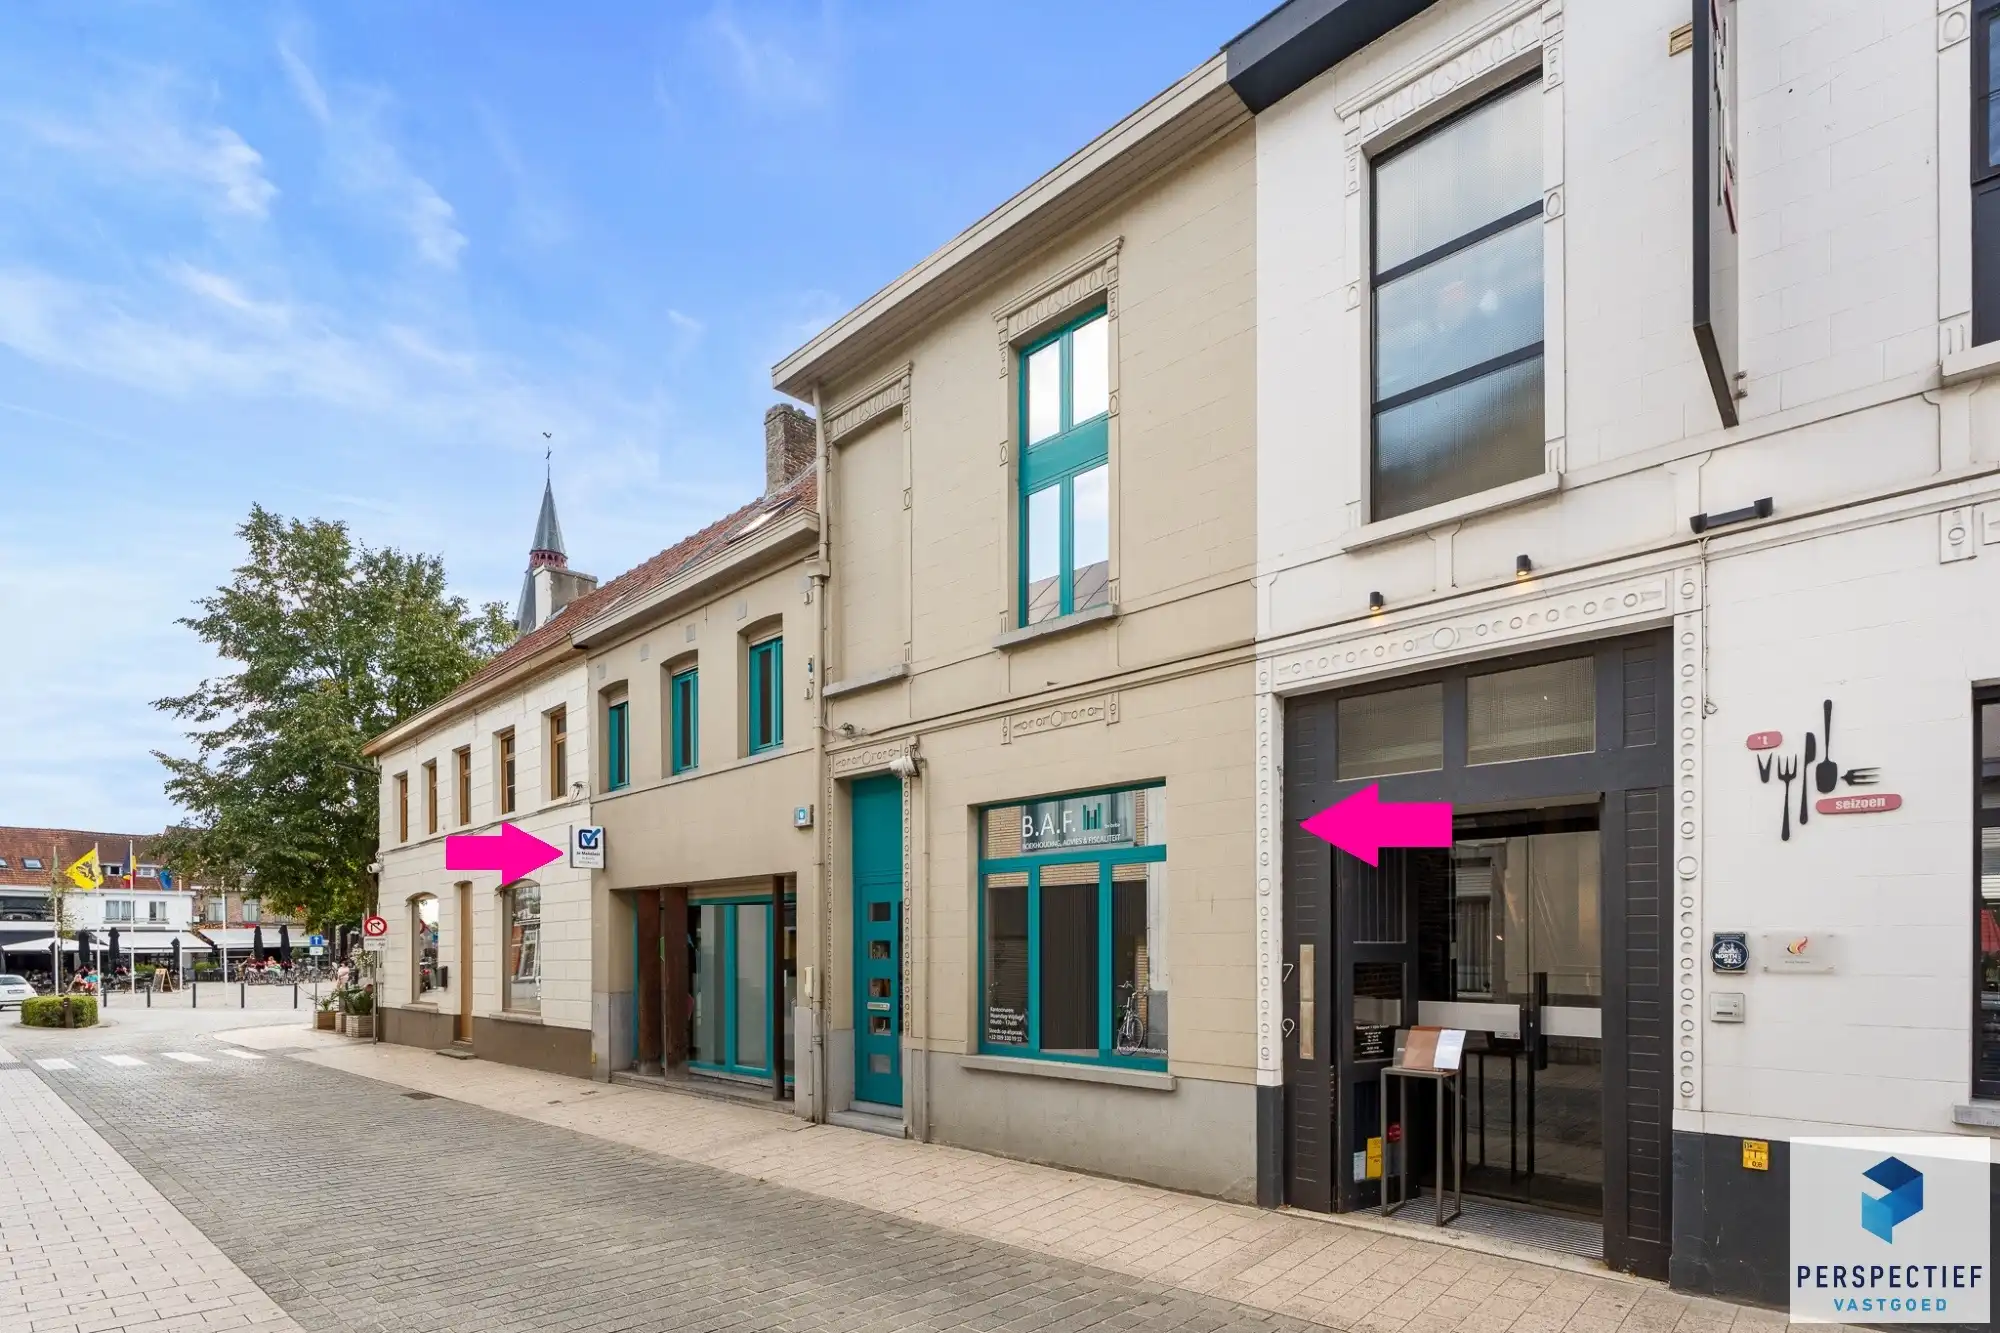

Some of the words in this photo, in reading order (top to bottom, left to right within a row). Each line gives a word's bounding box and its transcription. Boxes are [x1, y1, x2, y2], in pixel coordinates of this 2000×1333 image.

[1835, 797, 1886, 810] seizoen
[1022, 811, 1077, 838] B.A.F.
[1283, 963, 1294, 983] 7
[1281, 1018, 1295, 1038] 9
